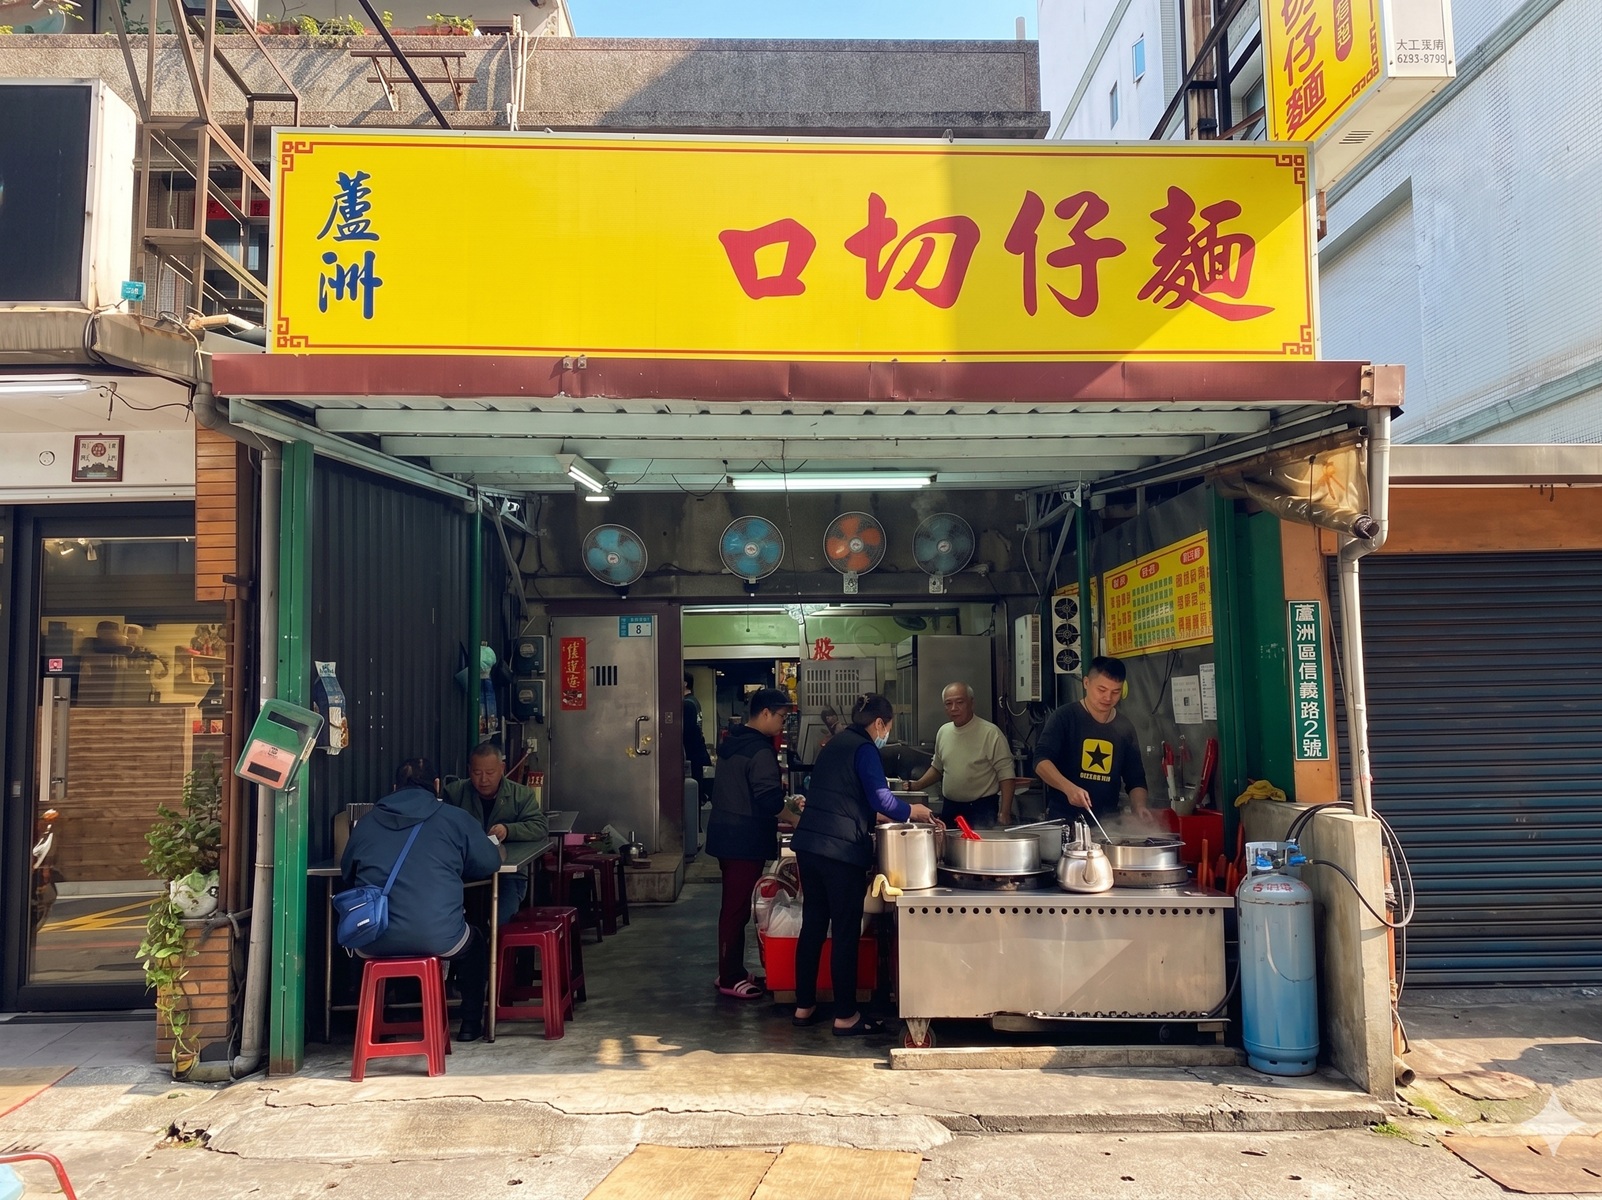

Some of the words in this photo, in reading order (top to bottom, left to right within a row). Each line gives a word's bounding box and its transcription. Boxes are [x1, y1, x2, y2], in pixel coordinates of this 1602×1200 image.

[316, 170, 384, 320] 蘆洲
[718, 185, 1276, 322] 口切仔麵
[635, 624, 642, 635] 8
[1294, 603, 1322, 758] 蘆洲區信義路2號
